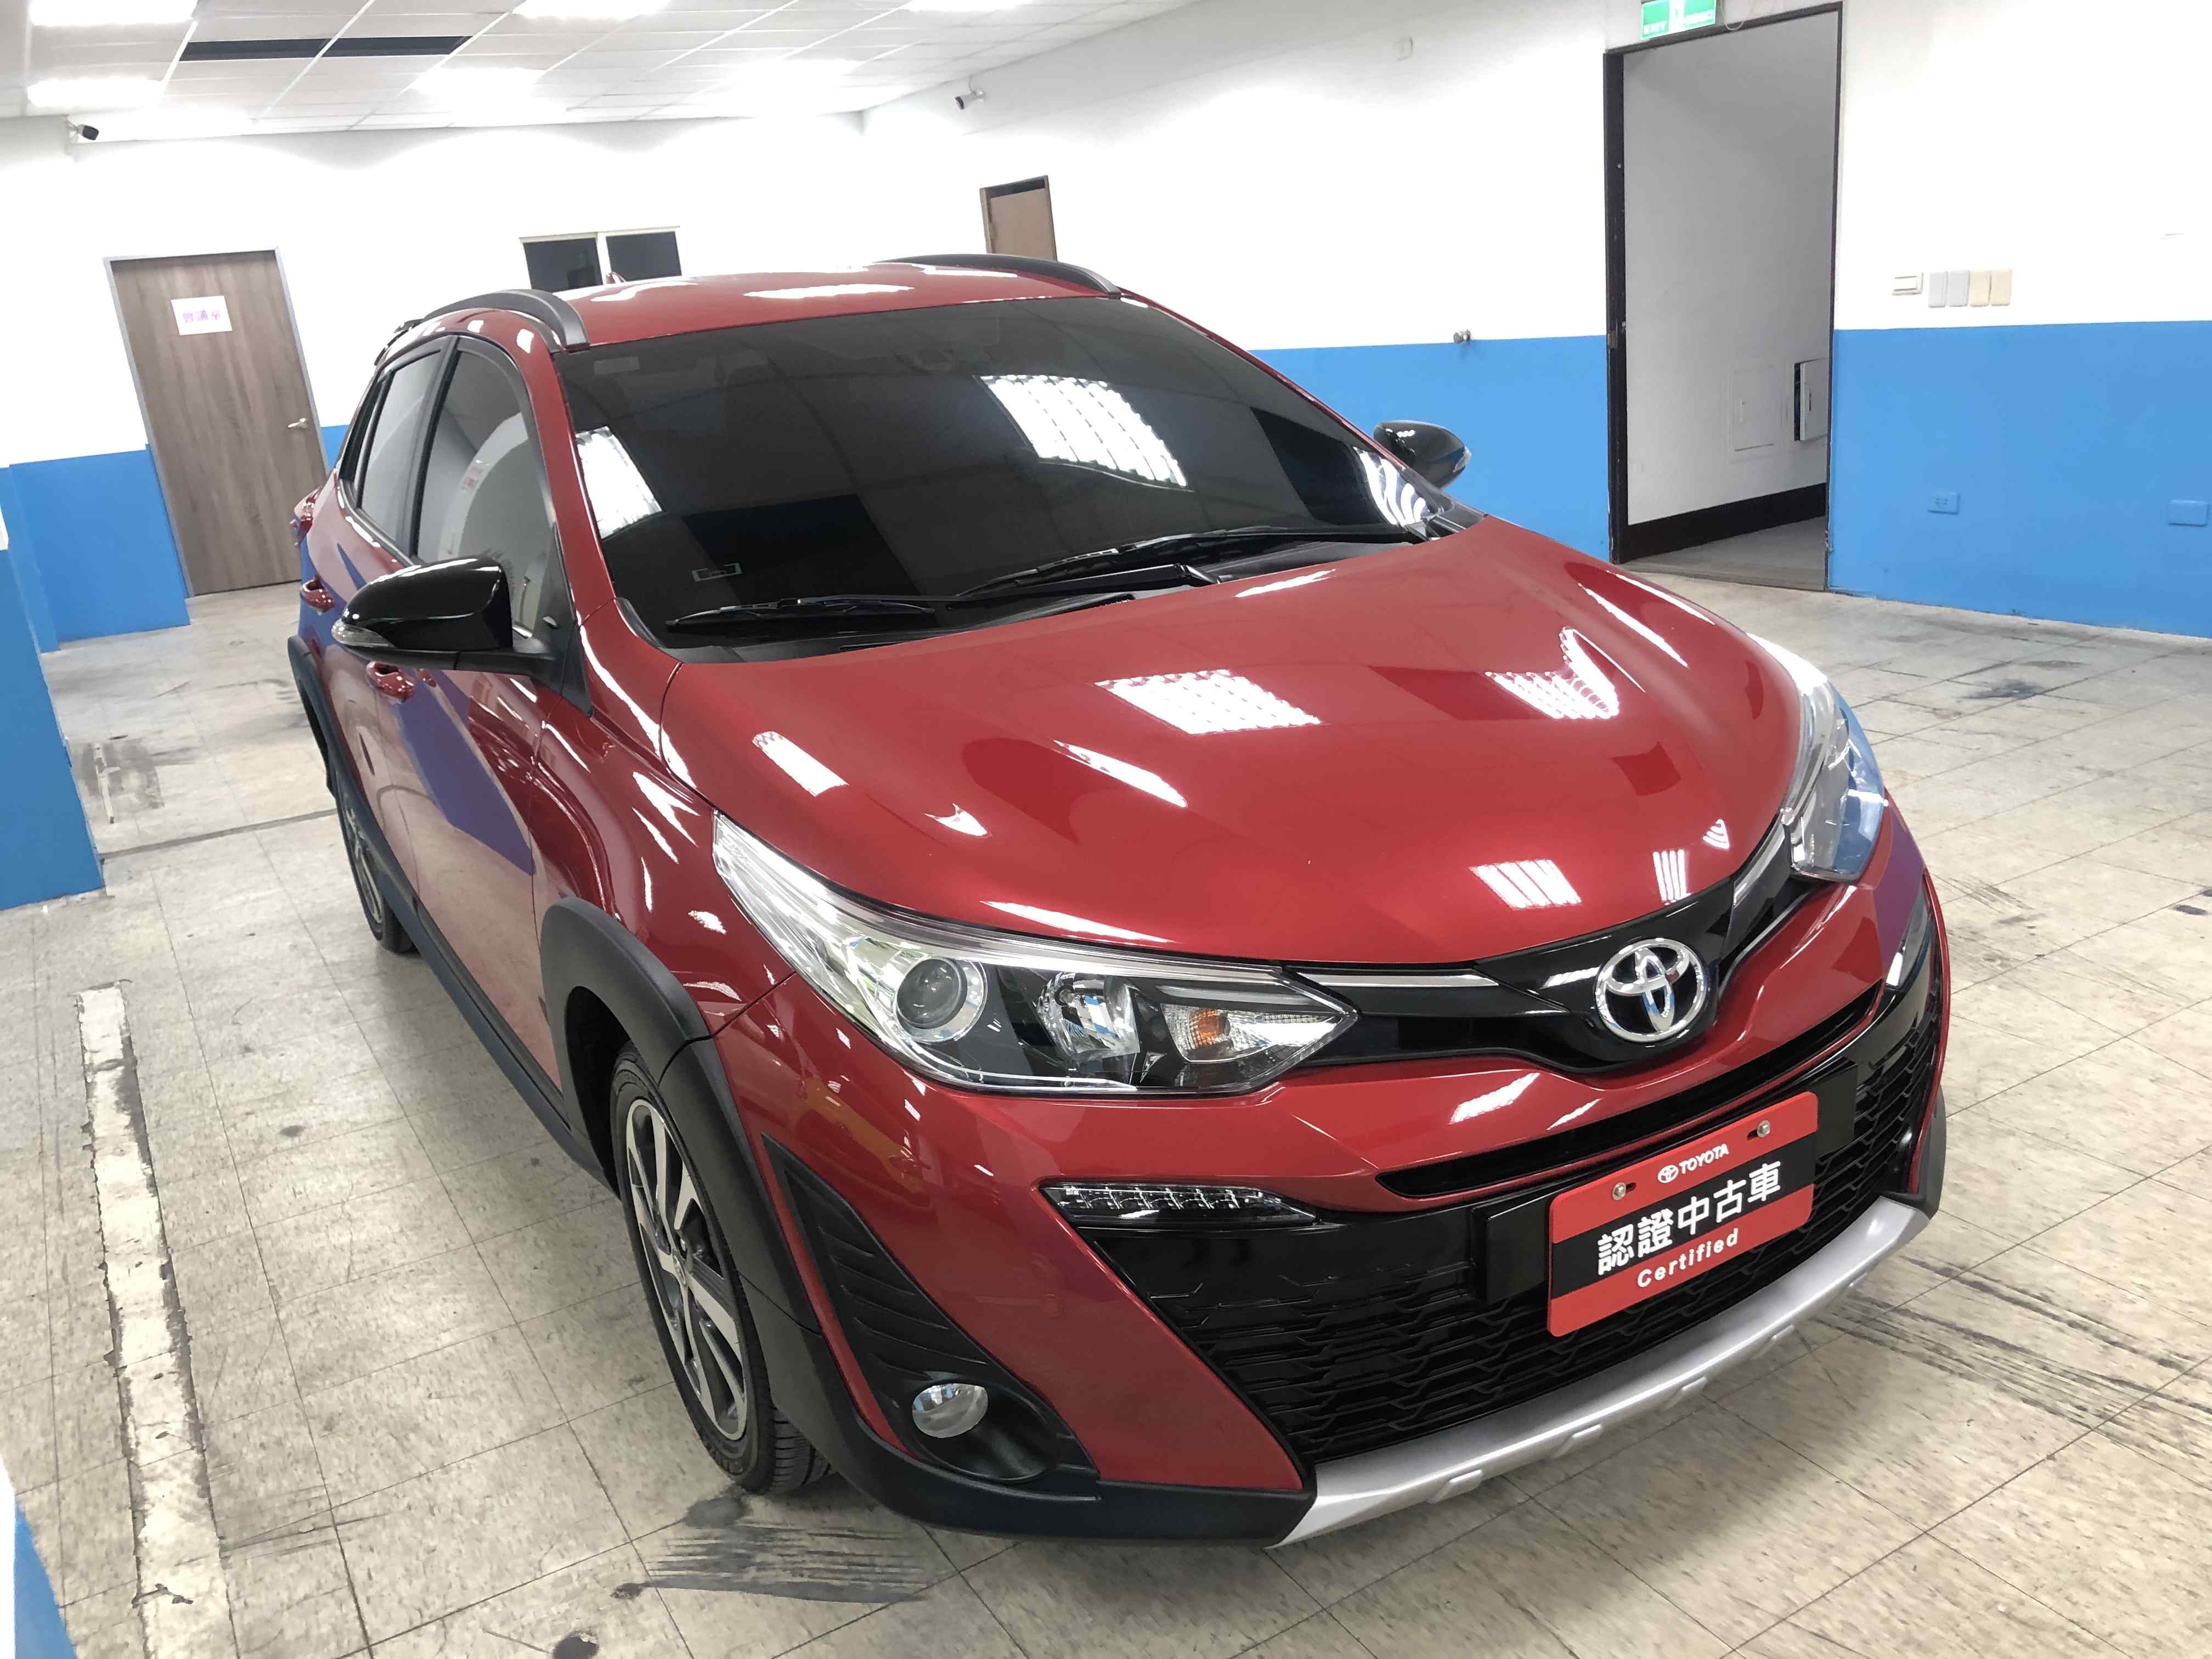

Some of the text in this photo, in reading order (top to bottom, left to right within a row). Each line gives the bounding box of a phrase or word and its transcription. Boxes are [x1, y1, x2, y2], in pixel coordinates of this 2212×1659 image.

[1679, 1143, 1729, 1174] TOYOTA
[1597, 1161, 1781, 1276] 認證中古車
[1638, 1228, 1739, 1288] Certified
